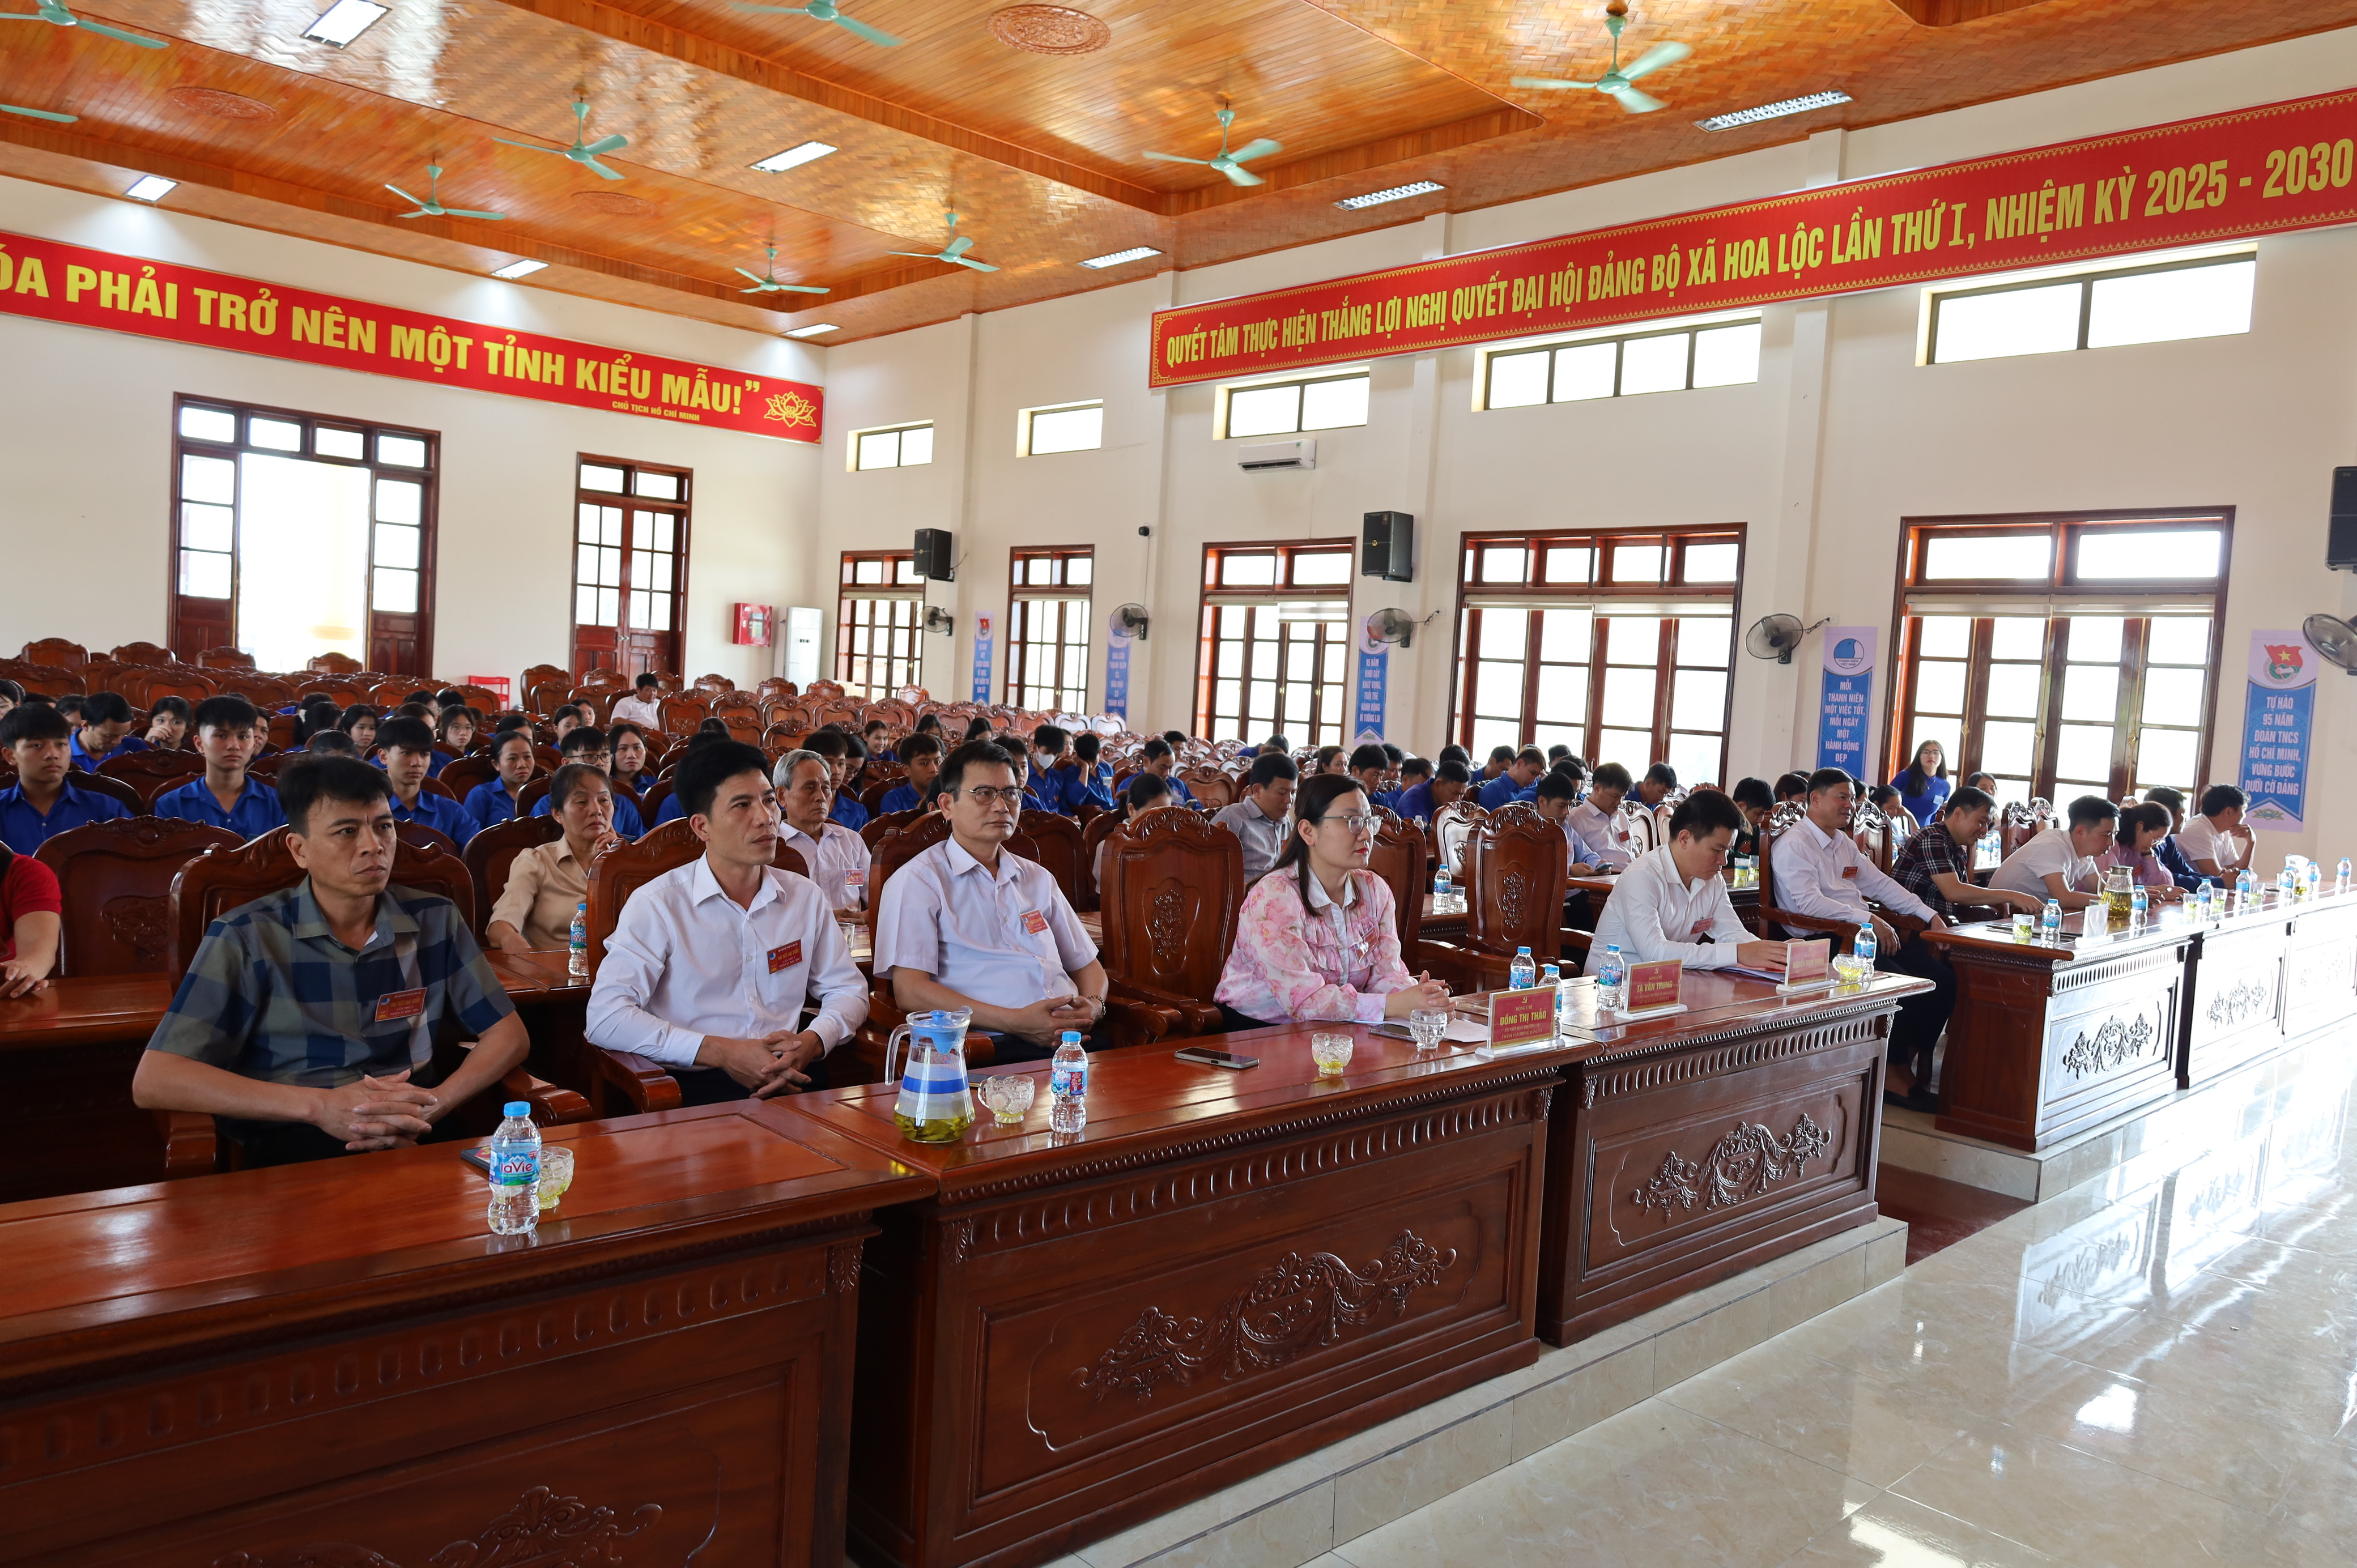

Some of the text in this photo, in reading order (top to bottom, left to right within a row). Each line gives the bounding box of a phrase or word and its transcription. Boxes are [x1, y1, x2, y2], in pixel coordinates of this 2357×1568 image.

[1167, 138, 2354, 366] QUYẾT TÂM THỰC HIỆN THẮNG LỢI NGHỊ QUYẾT ĐẠI HỘI ĐẢNG BỘ XÃ HOA LỘC LẦN THỨ I, NHIỆM KỲ 2025 - 2030
[66, 266, 177, 319] PHẢI
[194, 288, 279, 336] TRỞ
[292, 306, 376, 354] NÊN
[390, 325, 473, 373] MỘT
[484, 334, 564, 386] TỈNH
[576, 353, 651, 399] KIỂU
[612, 399, 700, 421] CHỦ TỊCH HỒ CHÍ MINH
[1840, 678, 1852, 690] MỖI
[1828, 691, 1864, 703] THANH NIÊN
[2266, 696, 2294, 711] TỰ HÀO
[1824, 702, 1865, 716] MỘT VIỆC TỐT,
[1830, 715, 1858, 727] MỖI NGÀY
[2262, 712, 2294, 727] 95 NĂM
[1837, 728, 1849, 740] MỘT
[2254, 728, 2299, 744] ĐOÀN TNCS
[1826, 739, 1859, 752] HÀNH ĐỘNG
[2249, 743, 2300, 762] HỒ CHÍ MINH,
[1835, 753, 1847, 764] ĐẸP
[2252, 761, 2295, 778] VỮNG BƯỚC
[2245, 777, 2299, 795] DƯỚI CỜ ĐẢNG
[1637, 981, 1673, 994] TẠ VĂN TRUNG
[1519, 1013, 1529, 1024] THỊ
[1531, 1008, 1547, 1021] THẢO
[500, 1161, 533, 1173] laVie
